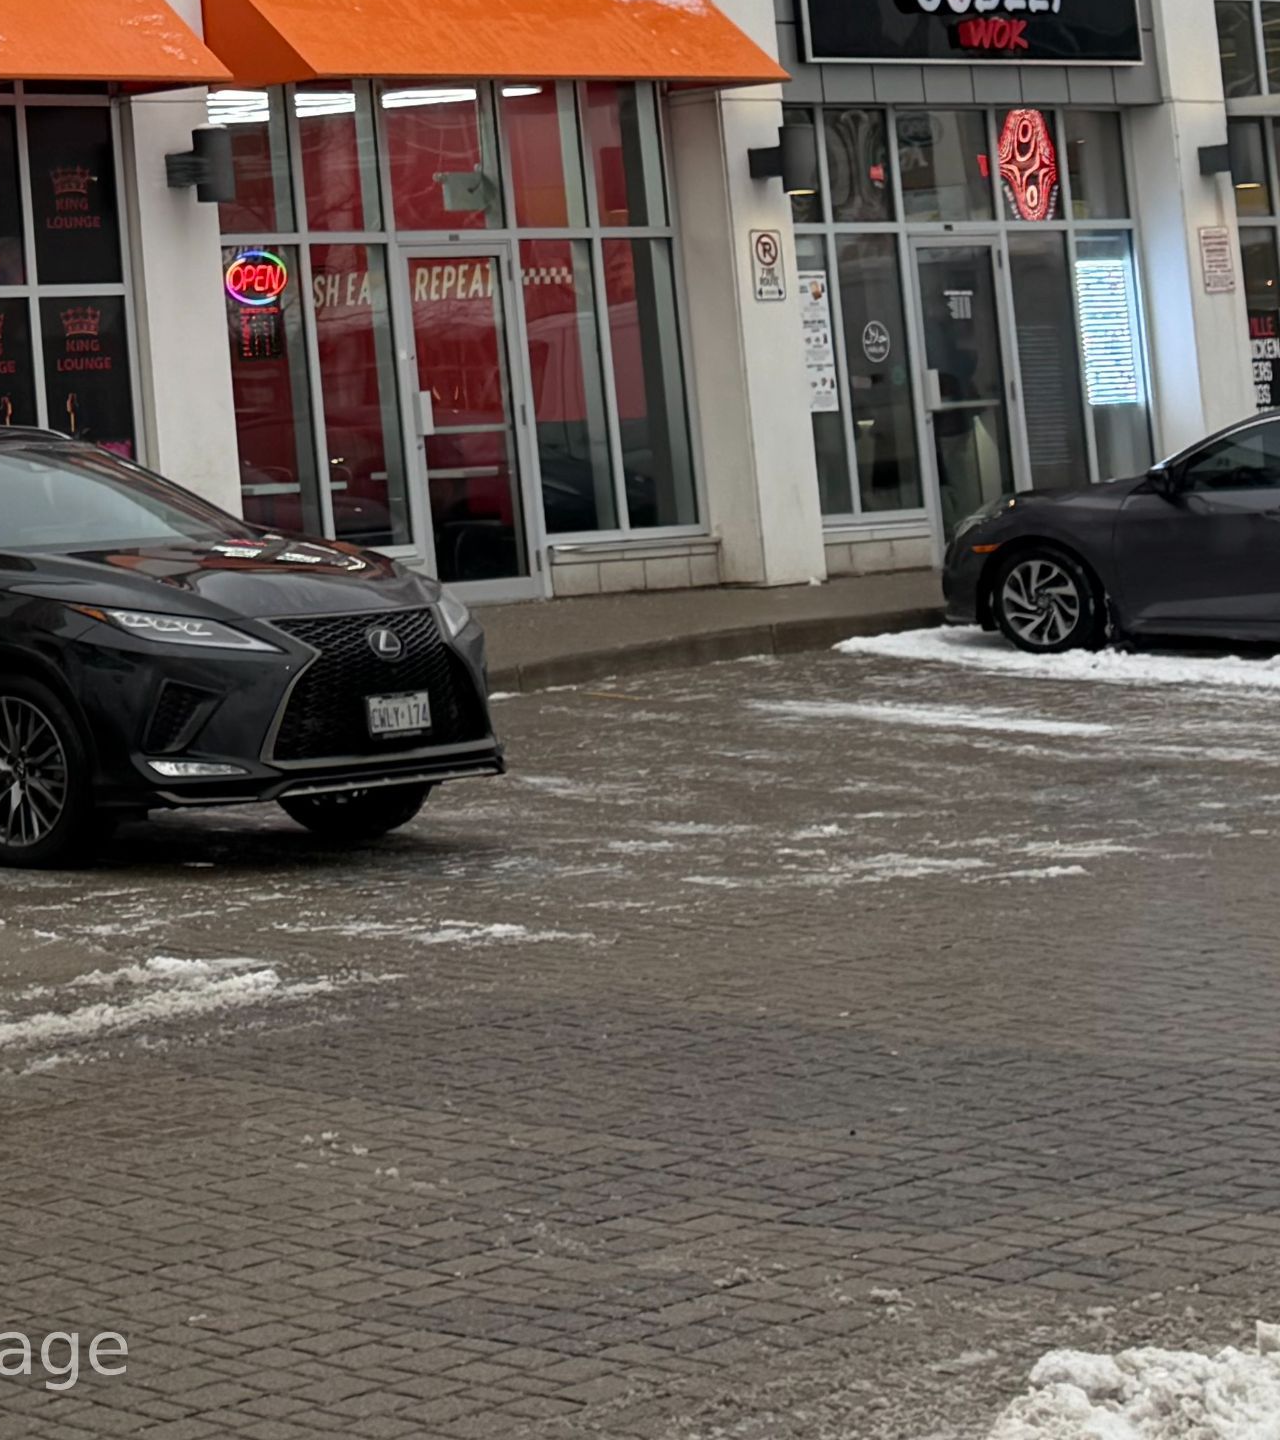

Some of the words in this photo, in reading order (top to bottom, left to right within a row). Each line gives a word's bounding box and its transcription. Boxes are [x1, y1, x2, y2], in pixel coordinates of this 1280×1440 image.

[965, 18, 1028, 49] WOK
[56, 198, 88, 211] KING
[46, 216, 101, 230] LOUNGE
[231, 265, 280, 291] OPEN
[313, 273, 339, 308] SH
[346, 272, 372, 306] EA
[66, 338, 100, 353] KING
[57, 356, 112, 372] LOUNGE
